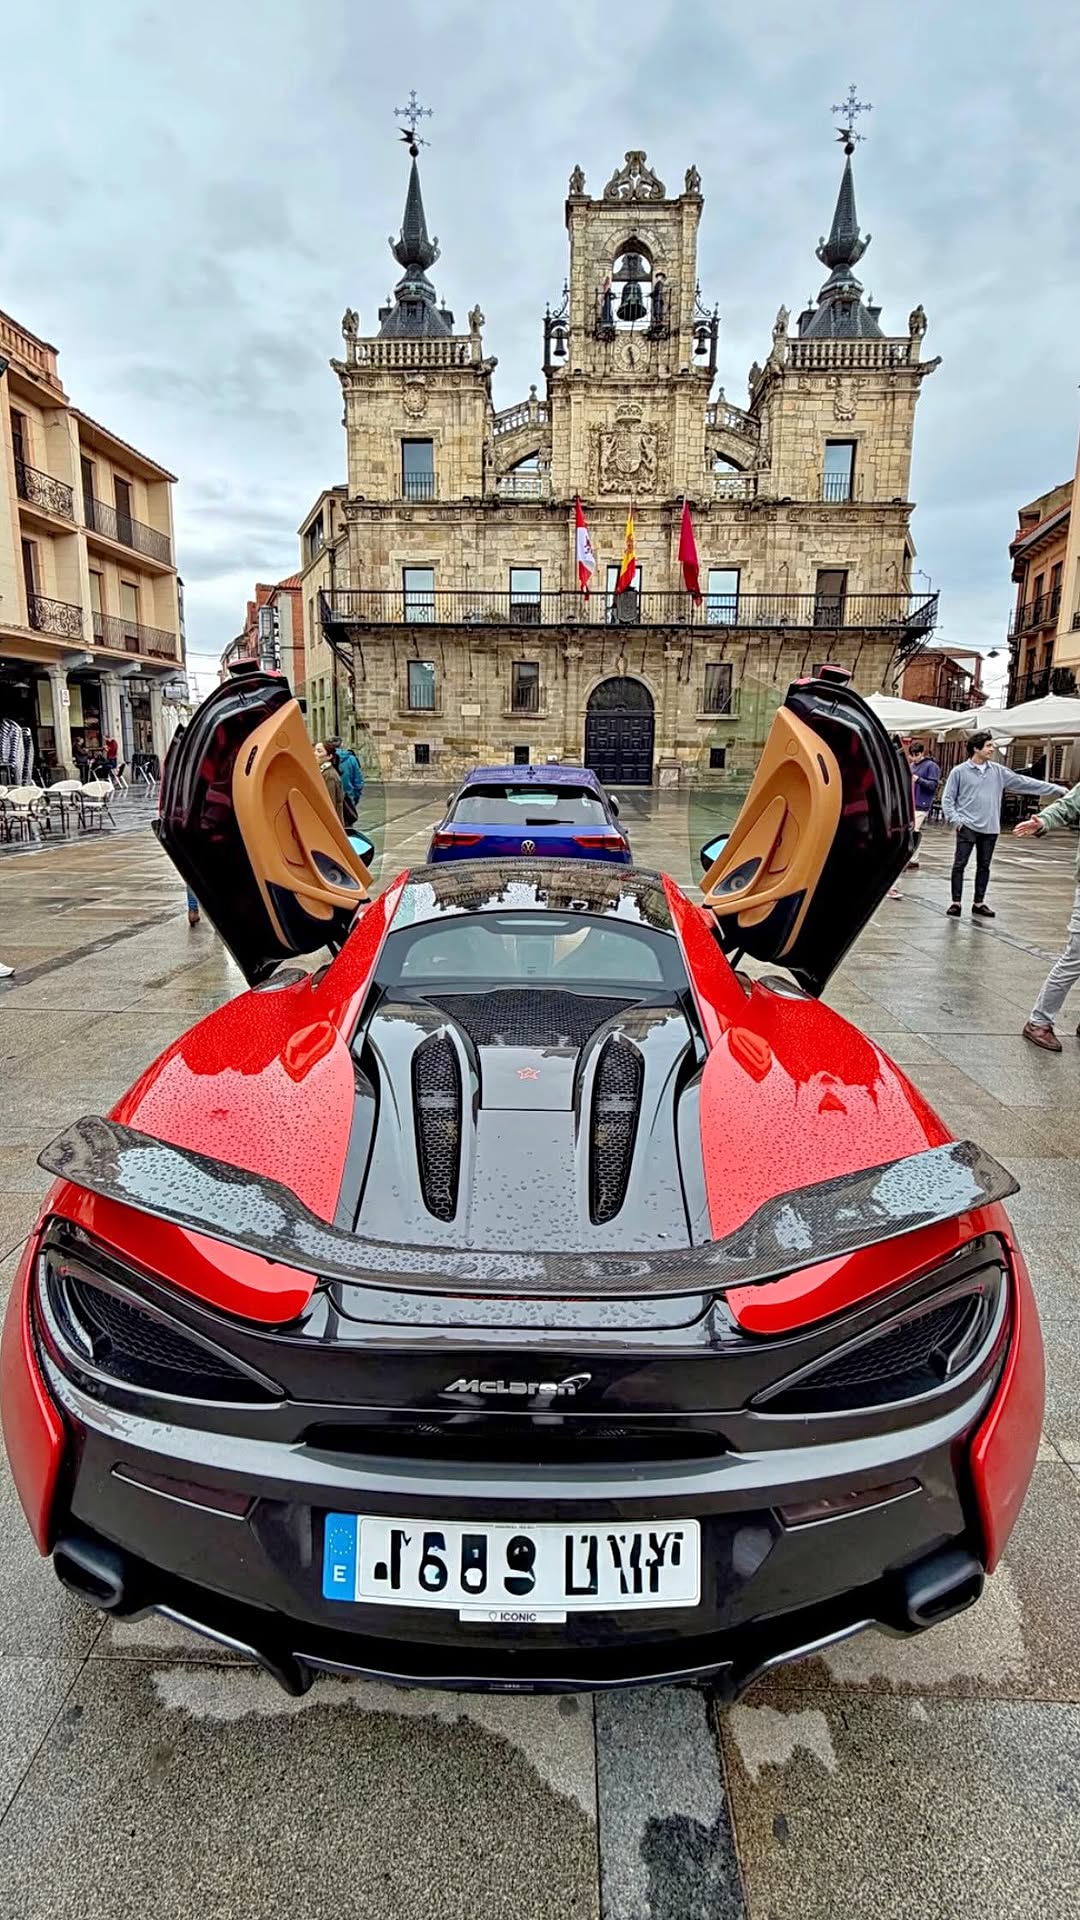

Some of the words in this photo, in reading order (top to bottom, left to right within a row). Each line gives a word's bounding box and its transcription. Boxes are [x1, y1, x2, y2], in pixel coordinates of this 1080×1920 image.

[444, 1379, 576, 1396] McLaren
[333, 1564, 347, 1583] E
[500, 1612, 537, 1622] ICONIC
